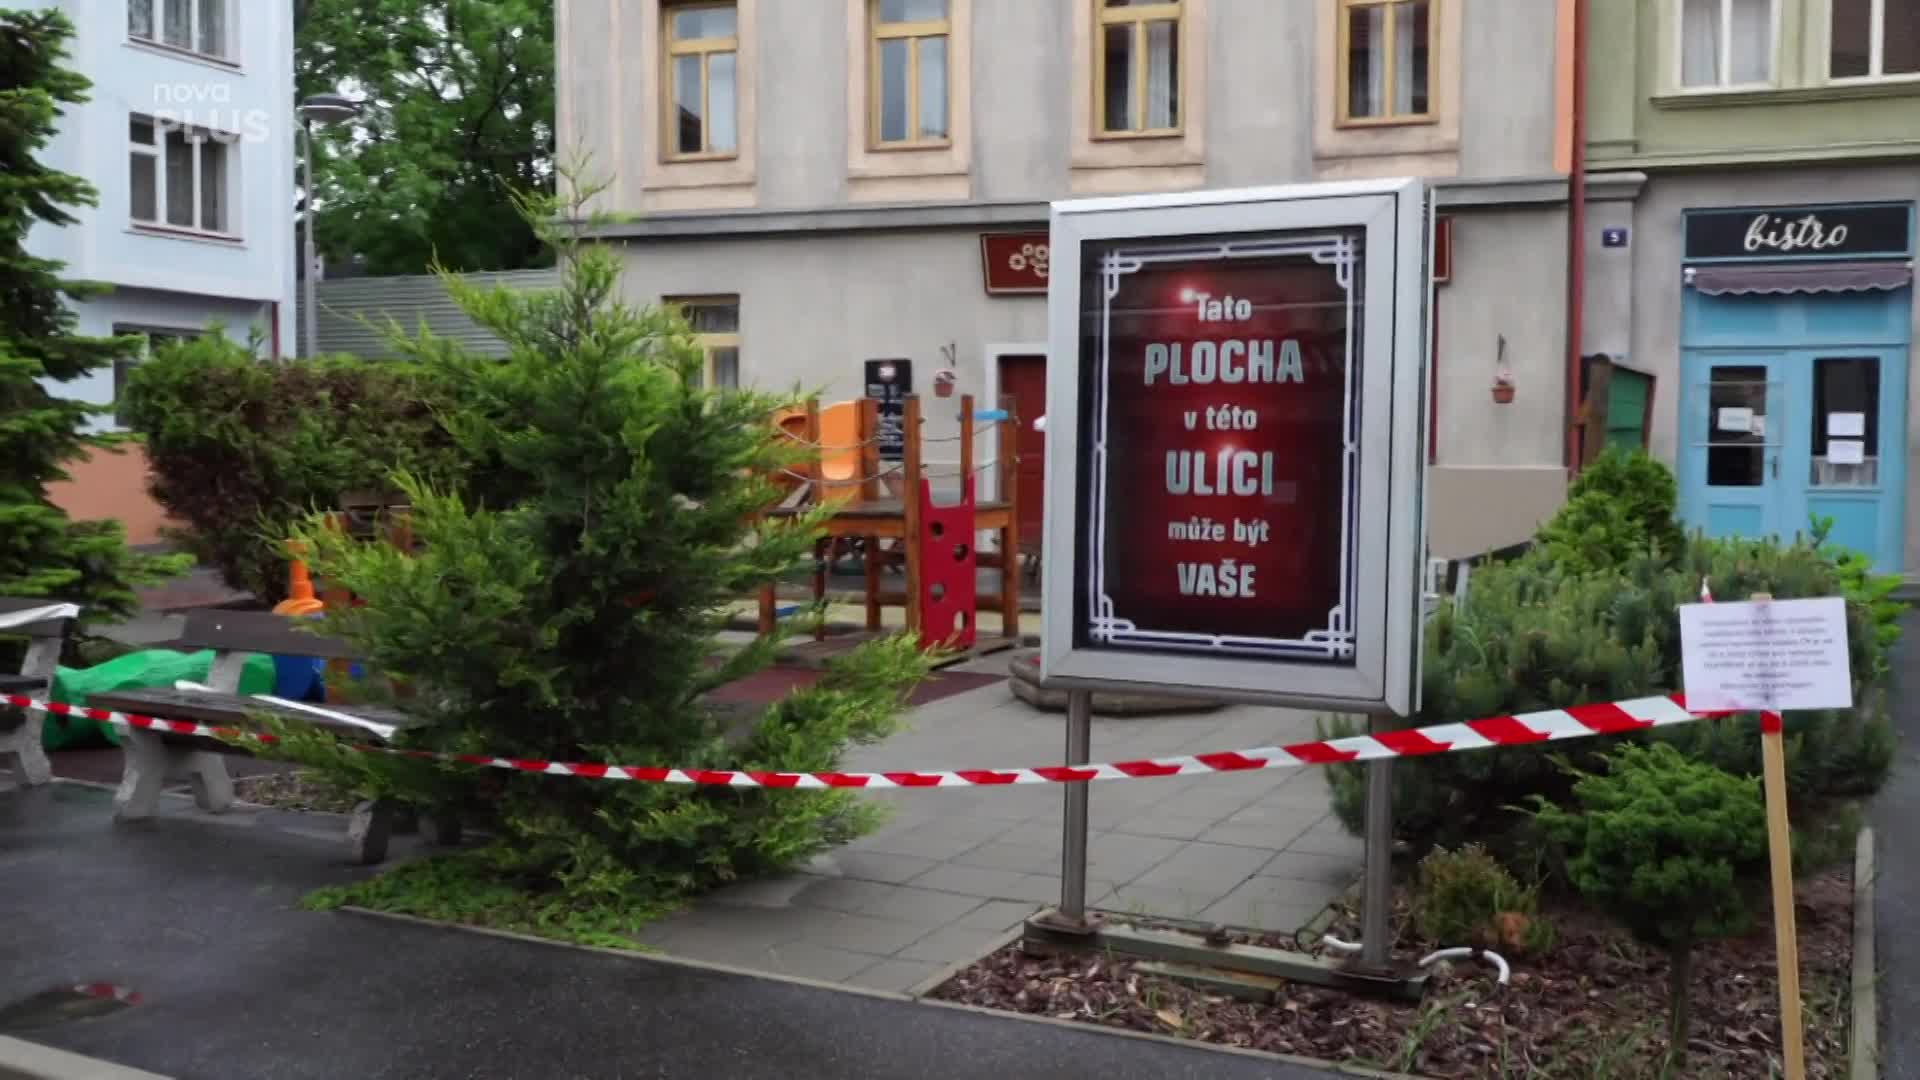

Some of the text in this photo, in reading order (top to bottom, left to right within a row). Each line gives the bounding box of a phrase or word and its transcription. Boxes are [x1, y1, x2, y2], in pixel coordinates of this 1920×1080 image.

[1744, 213, 1848, 251] bistro
[1195, 293, 1252, 321] Tato
[1144, 339, 1304, 385] PLOCHA
[1183, 403, 1258, 430] v této
[1167, 516, 1270, 547] může být
[1177, 558, 1257, 598] VAŠE
